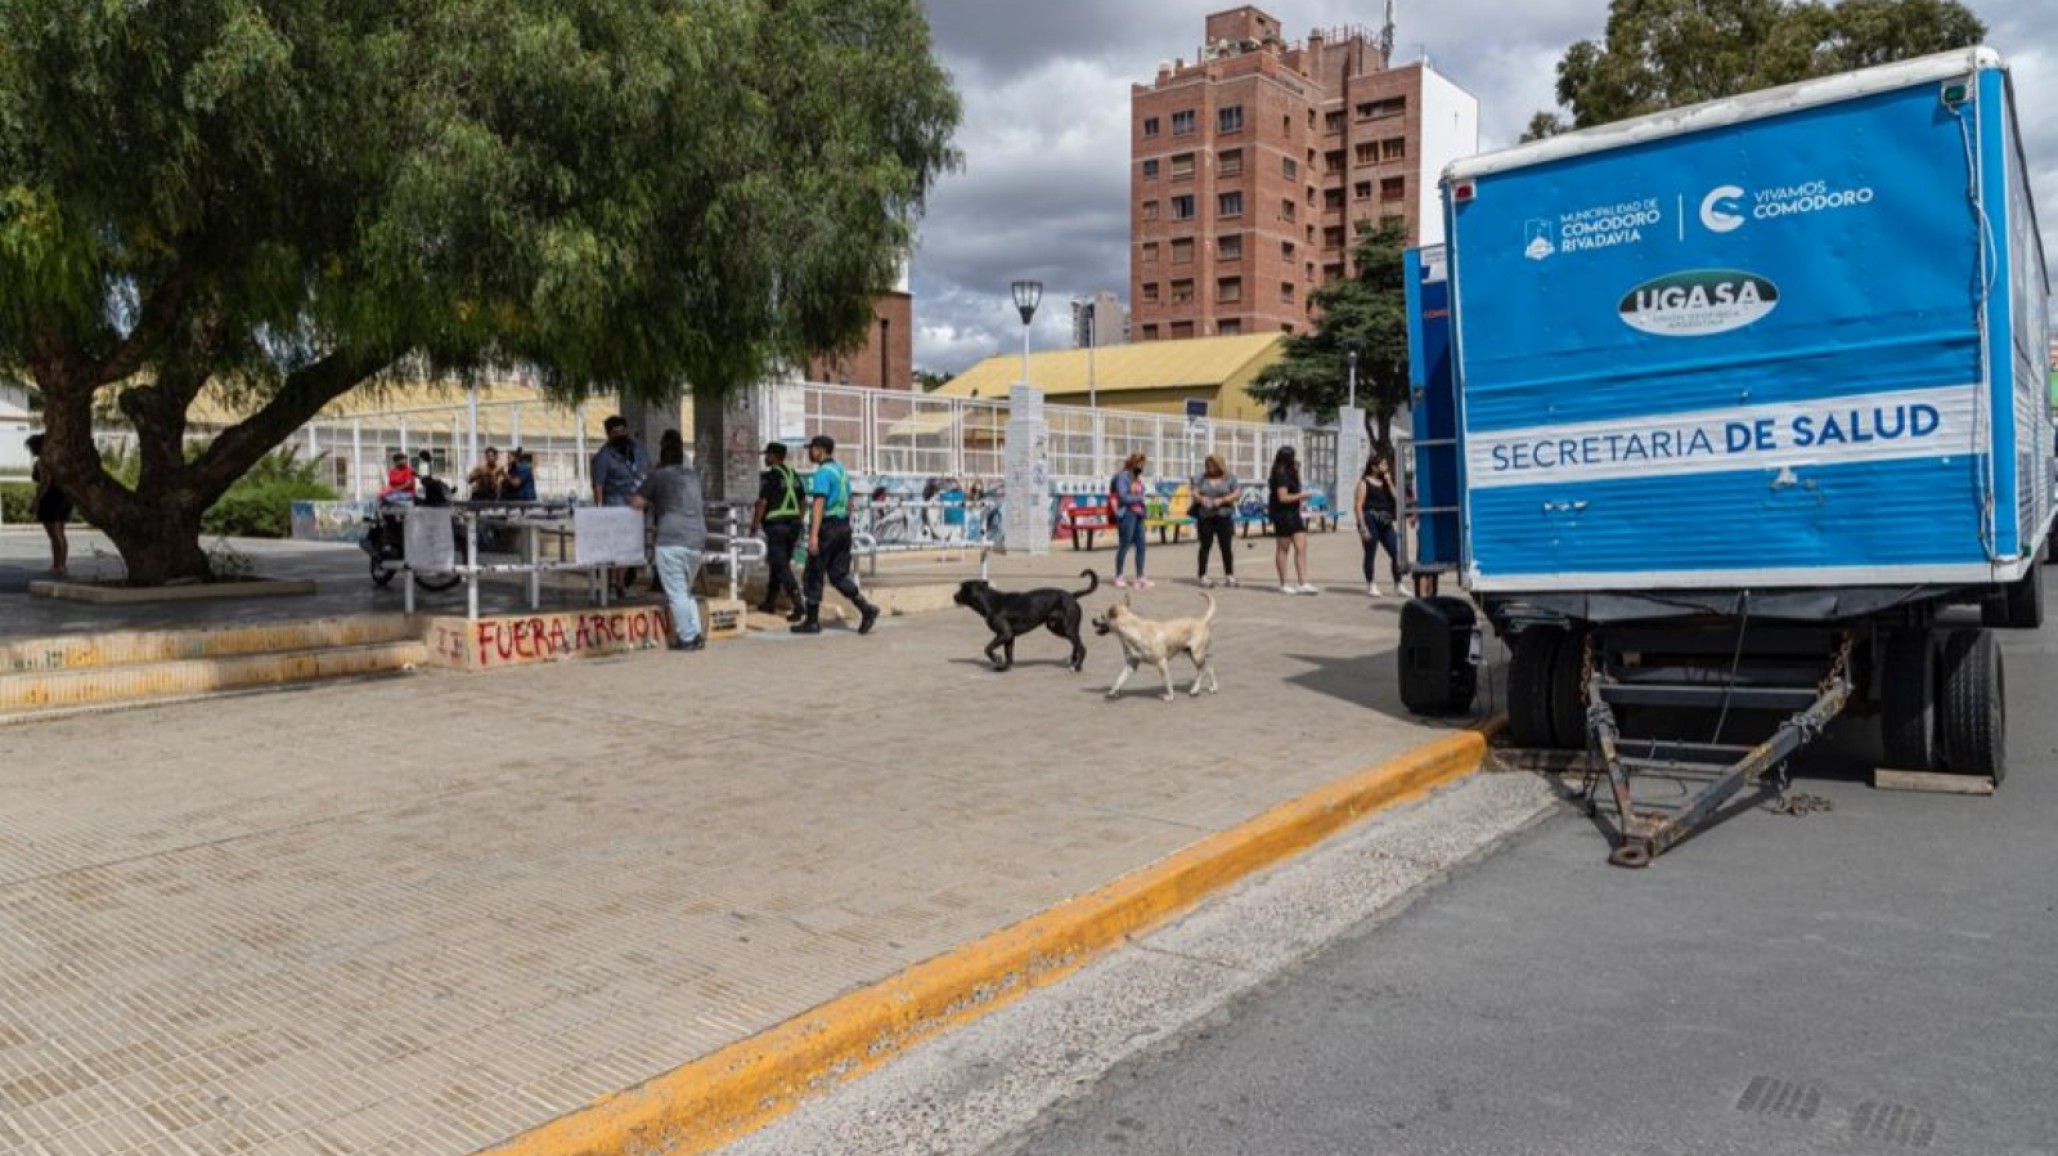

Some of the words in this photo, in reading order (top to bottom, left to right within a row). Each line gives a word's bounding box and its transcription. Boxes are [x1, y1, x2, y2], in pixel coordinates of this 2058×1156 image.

[1643, 197, 1659, 209] DE
[1753, 187, 1874, 219] COMODORO
[1754, 180, 1827, 203] VIVAMOS
[1561, 209, 1660, 237] COMODORO
[1561, 228, 1641, 253] RIVADAVIA
[1636, 280, 1761, 314] UGASA
[1492, 427, 1714, 472] SECRETARIA
[1725, 418, 1777, 454] DE
[1791, 403, 1940, 448] SALUD
[477, 617, 569, 666] FUERA
